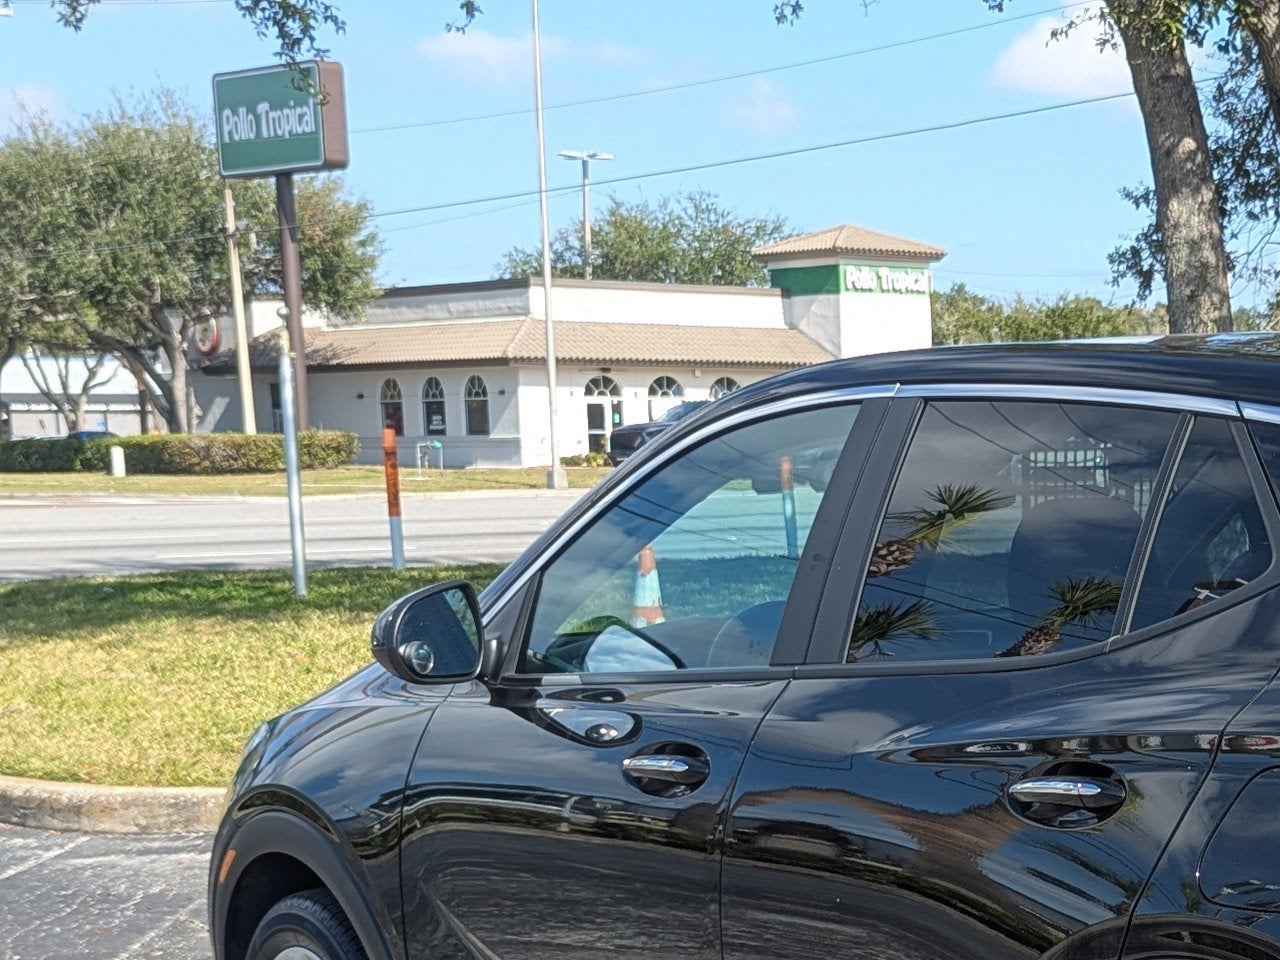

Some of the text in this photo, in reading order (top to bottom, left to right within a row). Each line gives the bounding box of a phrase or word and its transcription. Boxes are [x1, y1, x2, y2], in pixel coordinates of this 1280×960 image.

[222, 98, 316, 143] Pollo Tropical
[845, 264, 929, 295] Pollo Tropical
